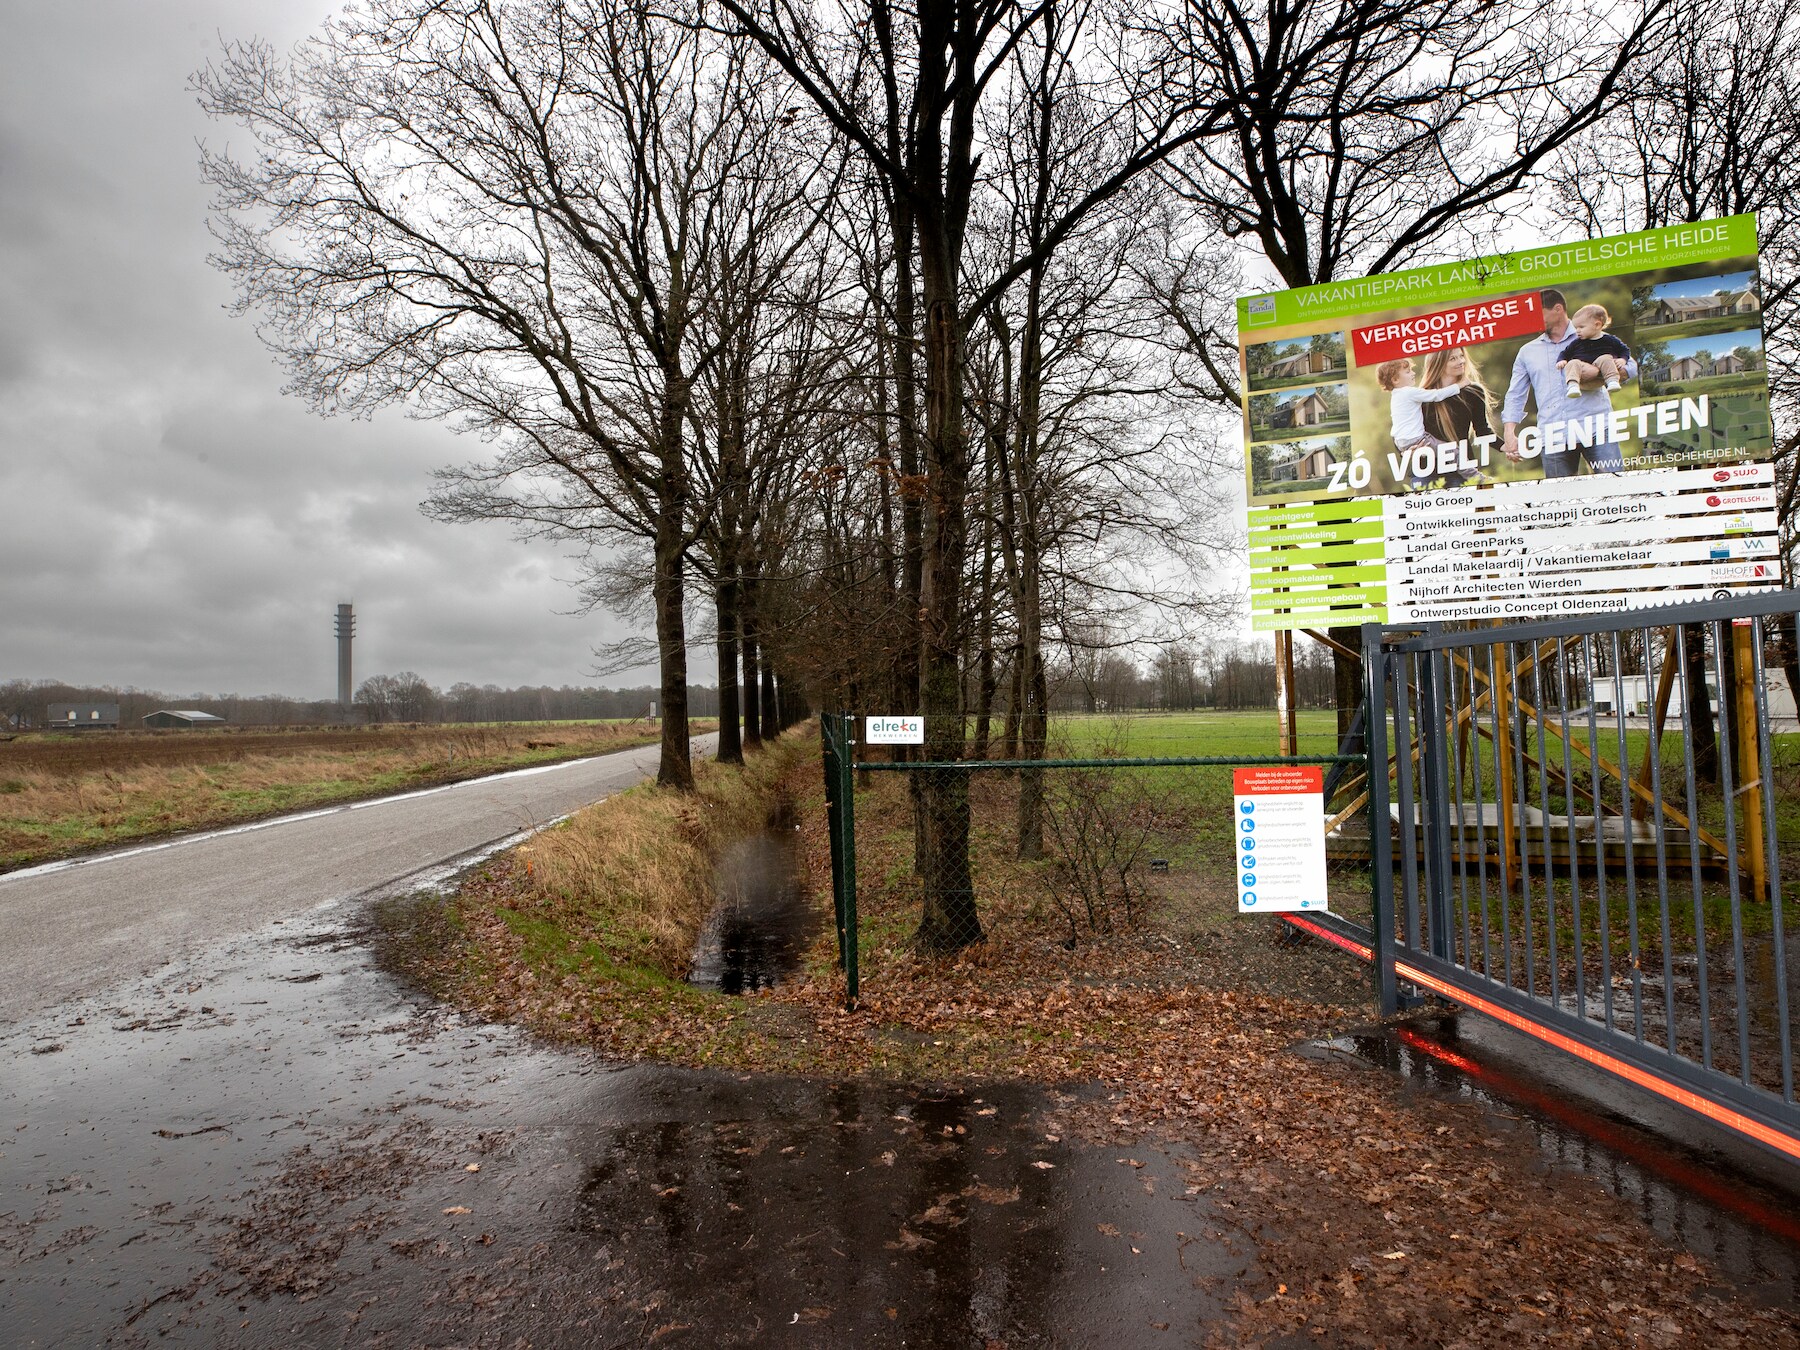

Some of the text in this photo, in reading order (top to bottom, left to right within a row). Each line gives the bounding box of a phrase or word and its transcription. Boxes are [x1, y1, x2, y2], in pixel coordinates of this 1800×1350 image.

[1295, 224, 1729, 307] VAKANTIEPARK LANDAL GROTELSCHE HEIDE
[1297, 305, 1349, 318] ONTWIKKELING
[1350, 302, 1360, 310] EN
[1362, 297, 1401, 309] REALISATIE
[1404, 293, 1417, 301] 140
[1485, 271, 1569, 289] RECREATIEWONINGEN
[1571, 262, 1612, 275] INCLUSIEF
[1615, 256, 1658, 269] CENTRALE
[1661, 245, 1731, 262] VOORZIENINGEN
[1250, 303, 1275, 313] Landal
[1360, 296, 1535, 345] VERKOOP FASE 1
[1401, 322, 1497, 354] GESTART
[1327, 394, 1709, 494] ZÓ VOELT GENIETEN
[1590, 446, 1750, 470] WWW.GROTELSCHEHEIDE.NL
[1733, 468, 1759, 477] SUJO
[1405, 496, 1473, 510] Sujo Groep
[1722, 495, 1760, 504] GROTELSCH
[1251, 511, 1315, 524] Opdrachtgever
[1406, 502, 1647, 531] Ontwikkelingsmaatschappij Grotelsch
[1724, 520, 1753, 528] Landal
[1252, 530, 1337, 544] Projectontwikkeling
[1407, 536, 1524, 553] Landal GreenParks
[1408, 550, 1652, 575] Landal Makelaardij / Vakantiemakelaar
[1711, 565, 1754, 576] NIJHOFF
[1253, 573, 1334, 586] Verkoopmakelaars
[1409, 578, 1582, 598] Nijhoff Architecten Wierden
[1254, 592, 1367, 607] Architect centrumgebouw
[1410, 597, 1628, 618] Ontwerpstudio Concept Oldenzaal
[1255, 615, 1379, 628] Architect recreatiewoningen
[872, 718, 918, 732] elreka
